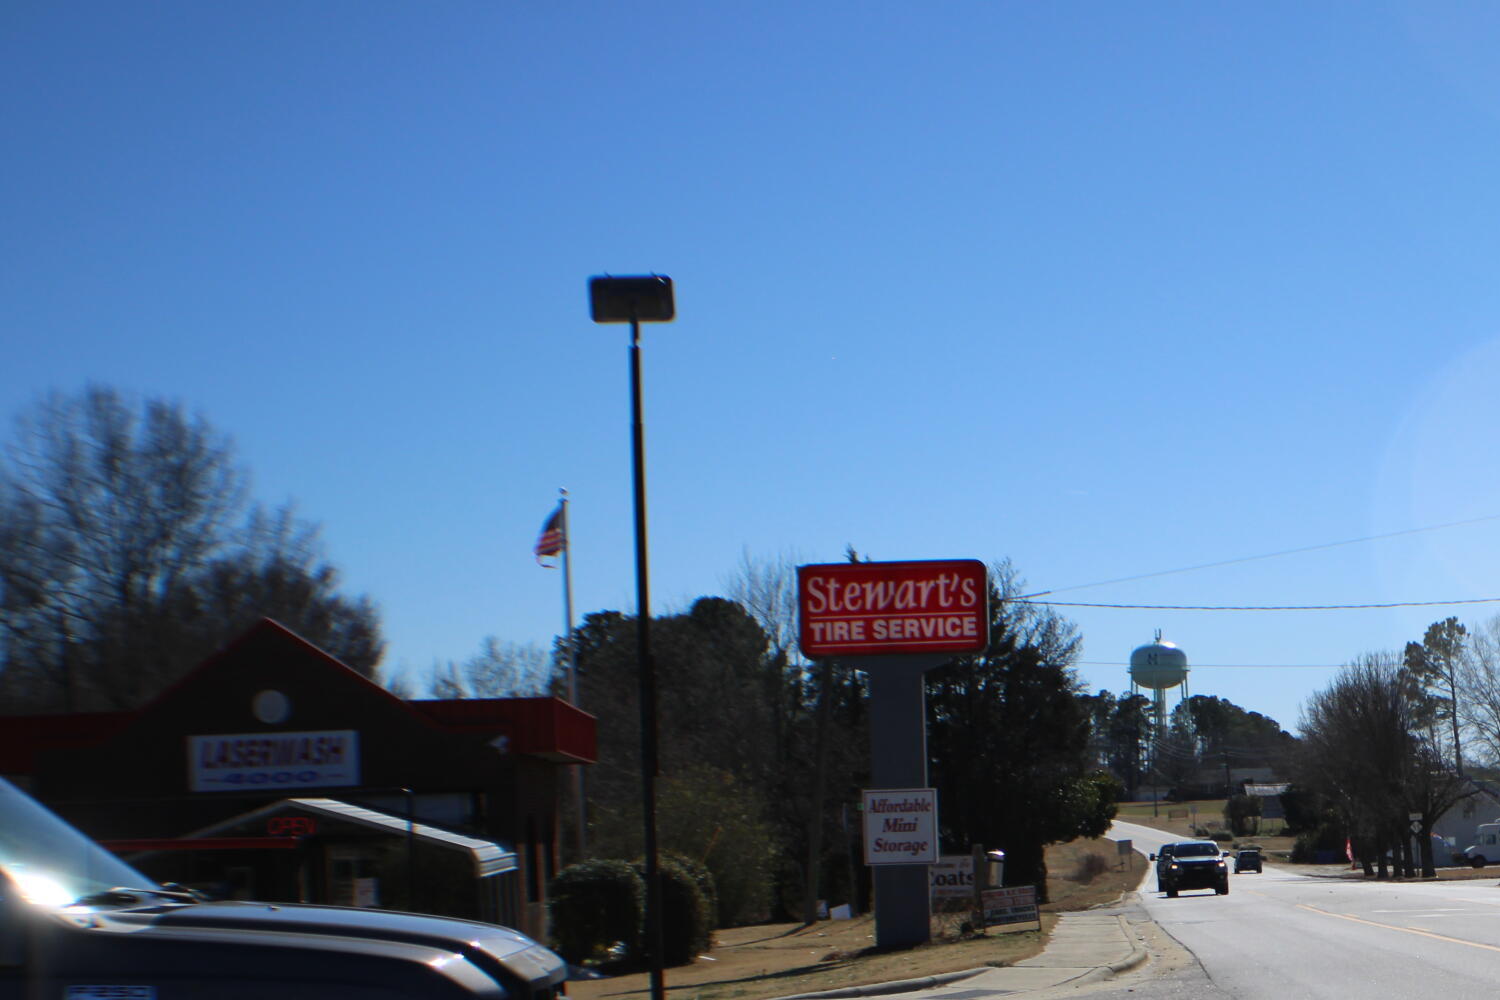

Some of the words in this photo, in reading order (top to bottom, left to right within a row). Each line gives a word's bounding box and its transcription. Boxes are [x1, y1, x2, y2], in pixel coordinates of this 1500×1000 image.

[807, 573, 977, 613] Stewart's
[809, 621, 866, 642] TIRE
[872, 616, 977, 640] SERVICE
[202, 736, 346, 769] LASERWASH
[869, 797, 932, 814] Affordable
[267, 816, 317, 836] OPEN
[882, 816, 918, 833] Mini
[873, 838, 930, 857] Storage
